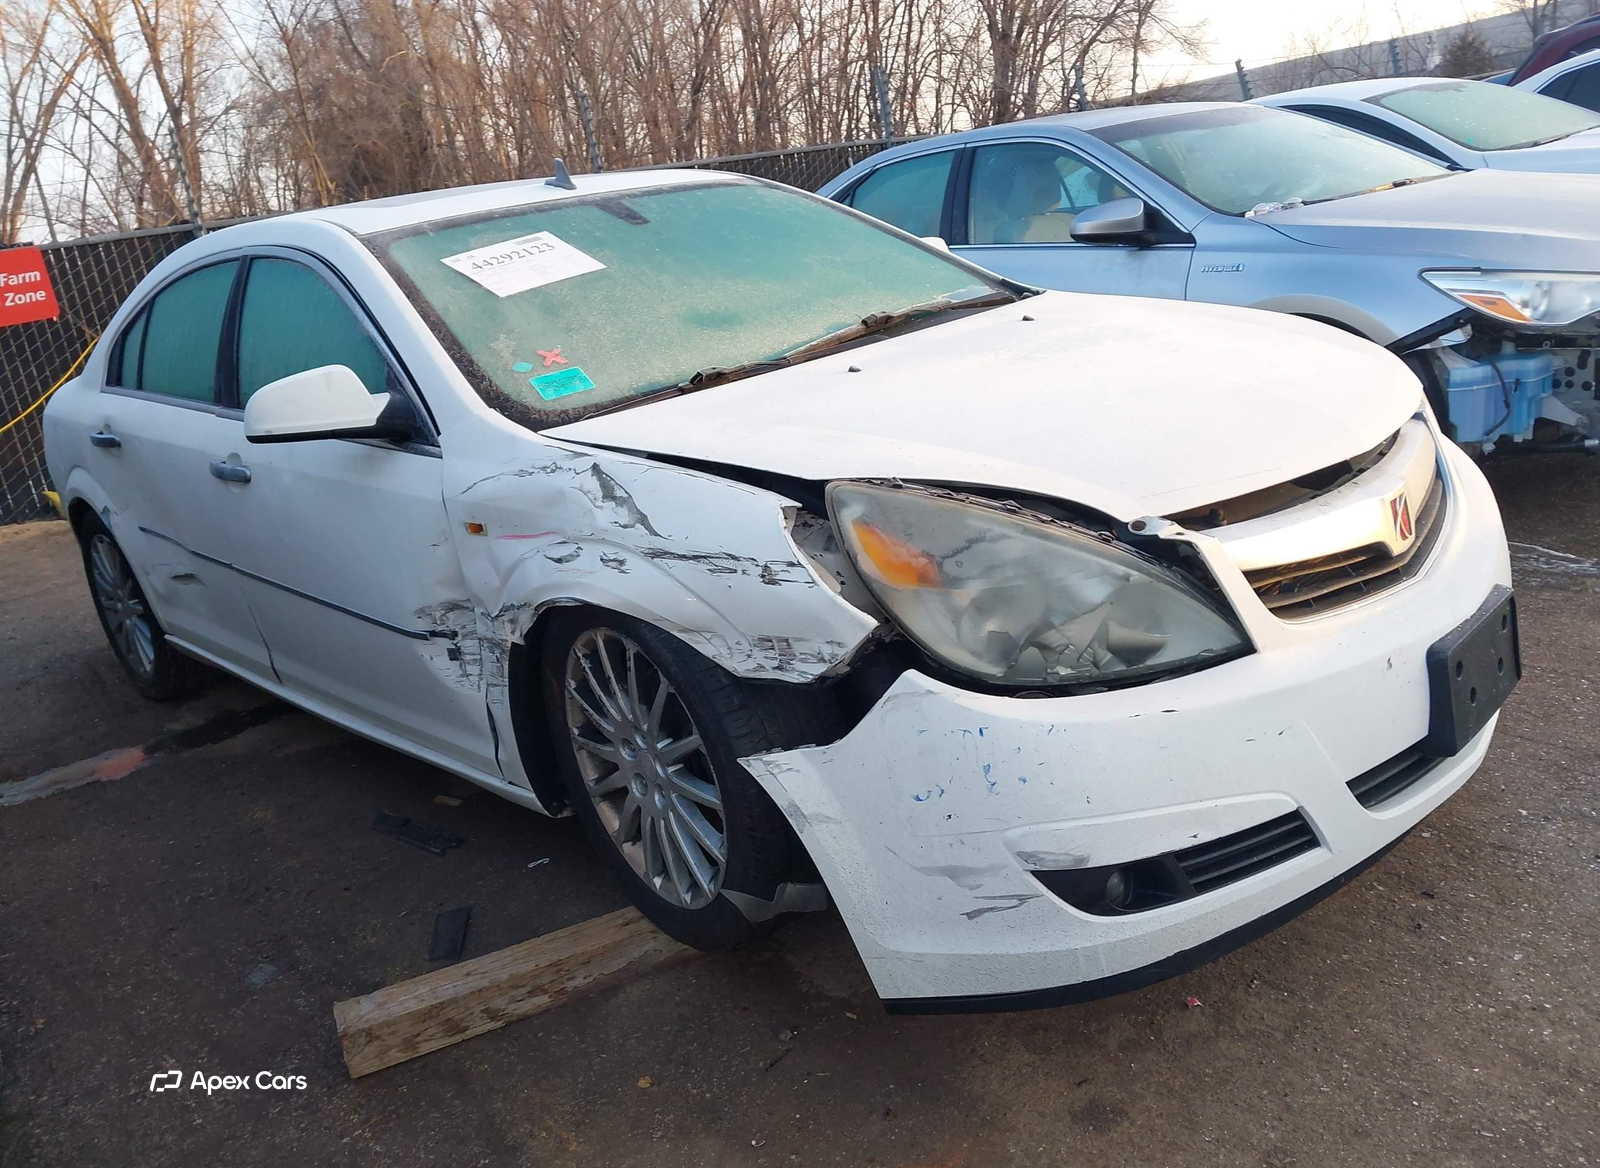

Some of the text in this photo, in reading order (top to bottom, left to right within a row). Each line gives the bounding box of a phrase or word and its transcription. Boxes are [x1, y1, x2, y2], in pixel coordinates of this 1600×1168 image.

[471, 242, 555, 270] 44292123
[0, 271, 41, 287] Farm
[4, 290, 46, 306] Zone
